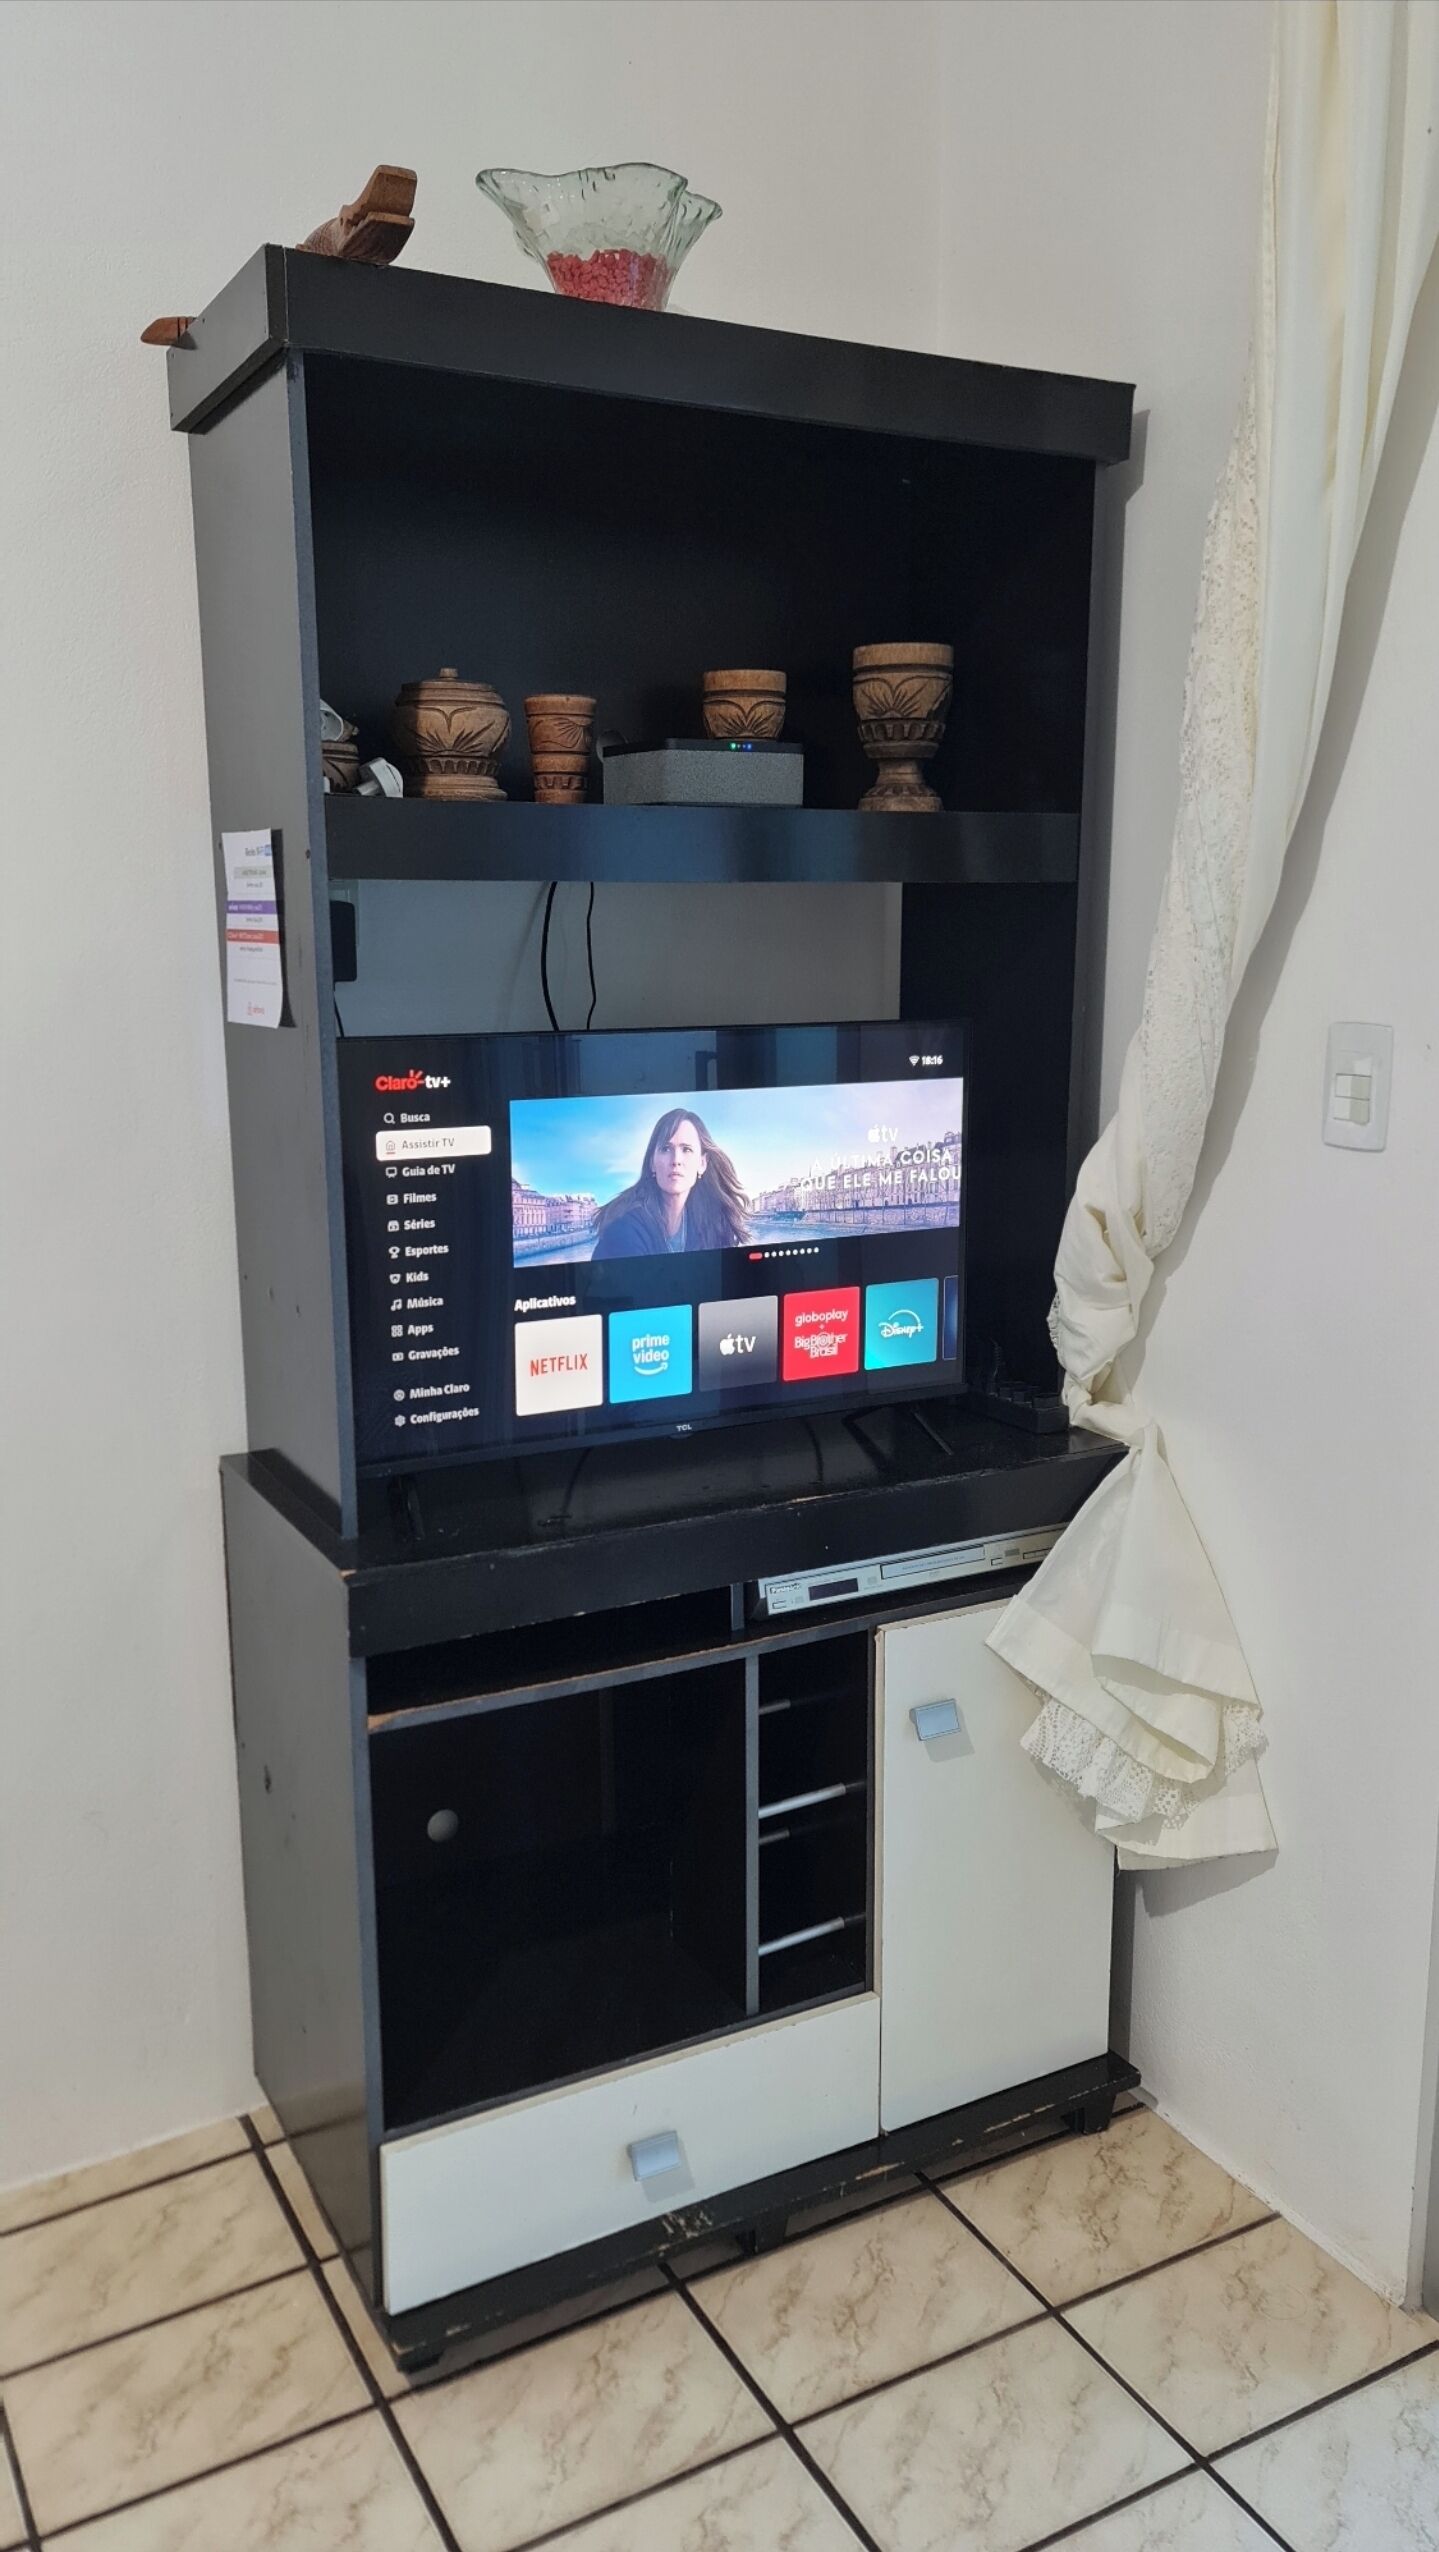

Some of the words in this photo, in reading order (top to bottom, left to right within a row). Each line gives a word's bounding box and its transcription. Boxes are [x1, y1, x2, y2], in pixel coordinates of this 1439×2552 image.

[921, 1054, 944, 1066] 18:16
[375, 1071, 421, 1091] Claro
[424, 1075, 451, 1089] tv+
[400, 1112, 431, 1124] Busca
[402, 1138, 440, 1150] Assistir
[442, 1137, 455, 1148] TV
[900, 1149, 953, 1165] COISA
[402, 1166, 426, 1177] Guia
[427, 1164, 440, 1175] de
[441, 1163, 456, 1175] TV
[800, 1176, 836, 1191] QUE
[843, 1173, 871, 1189] ELE
[879, 1170, 904, 1187] ME
[910, 1166, 961, 1184] FALOU
[403, 1192, 437, 1204] Filmes
[403, 1218, 436, 1231] Séries
[405, 1244, 449, 1258] Esportes
[406, 1271, 430, 1283] Kids
[407, 1296, 444, 1310] Música
[514, 1295, 576, 1312] Aplicativos
[794, 1308, 848, 1327] globoplay
[407, 1323, 434, 1337] Apps
[632, 1333, 670, 1351] prime
[737, 1334, 757, 1354] tv
[794, 1335, 811, 1351] Big
[408, 1346, 460, 1360] Gravações
[632, 1348, 670, 1364] video
[530, 1353, 588, 1377] NETFLIX
[410, 1386, 443, 1399] Minha
[444, 1383, 470, 1394] Claro
[410, 1407, 480, 1424] Configurações
[676, 1423, 693, 1432] TCL
